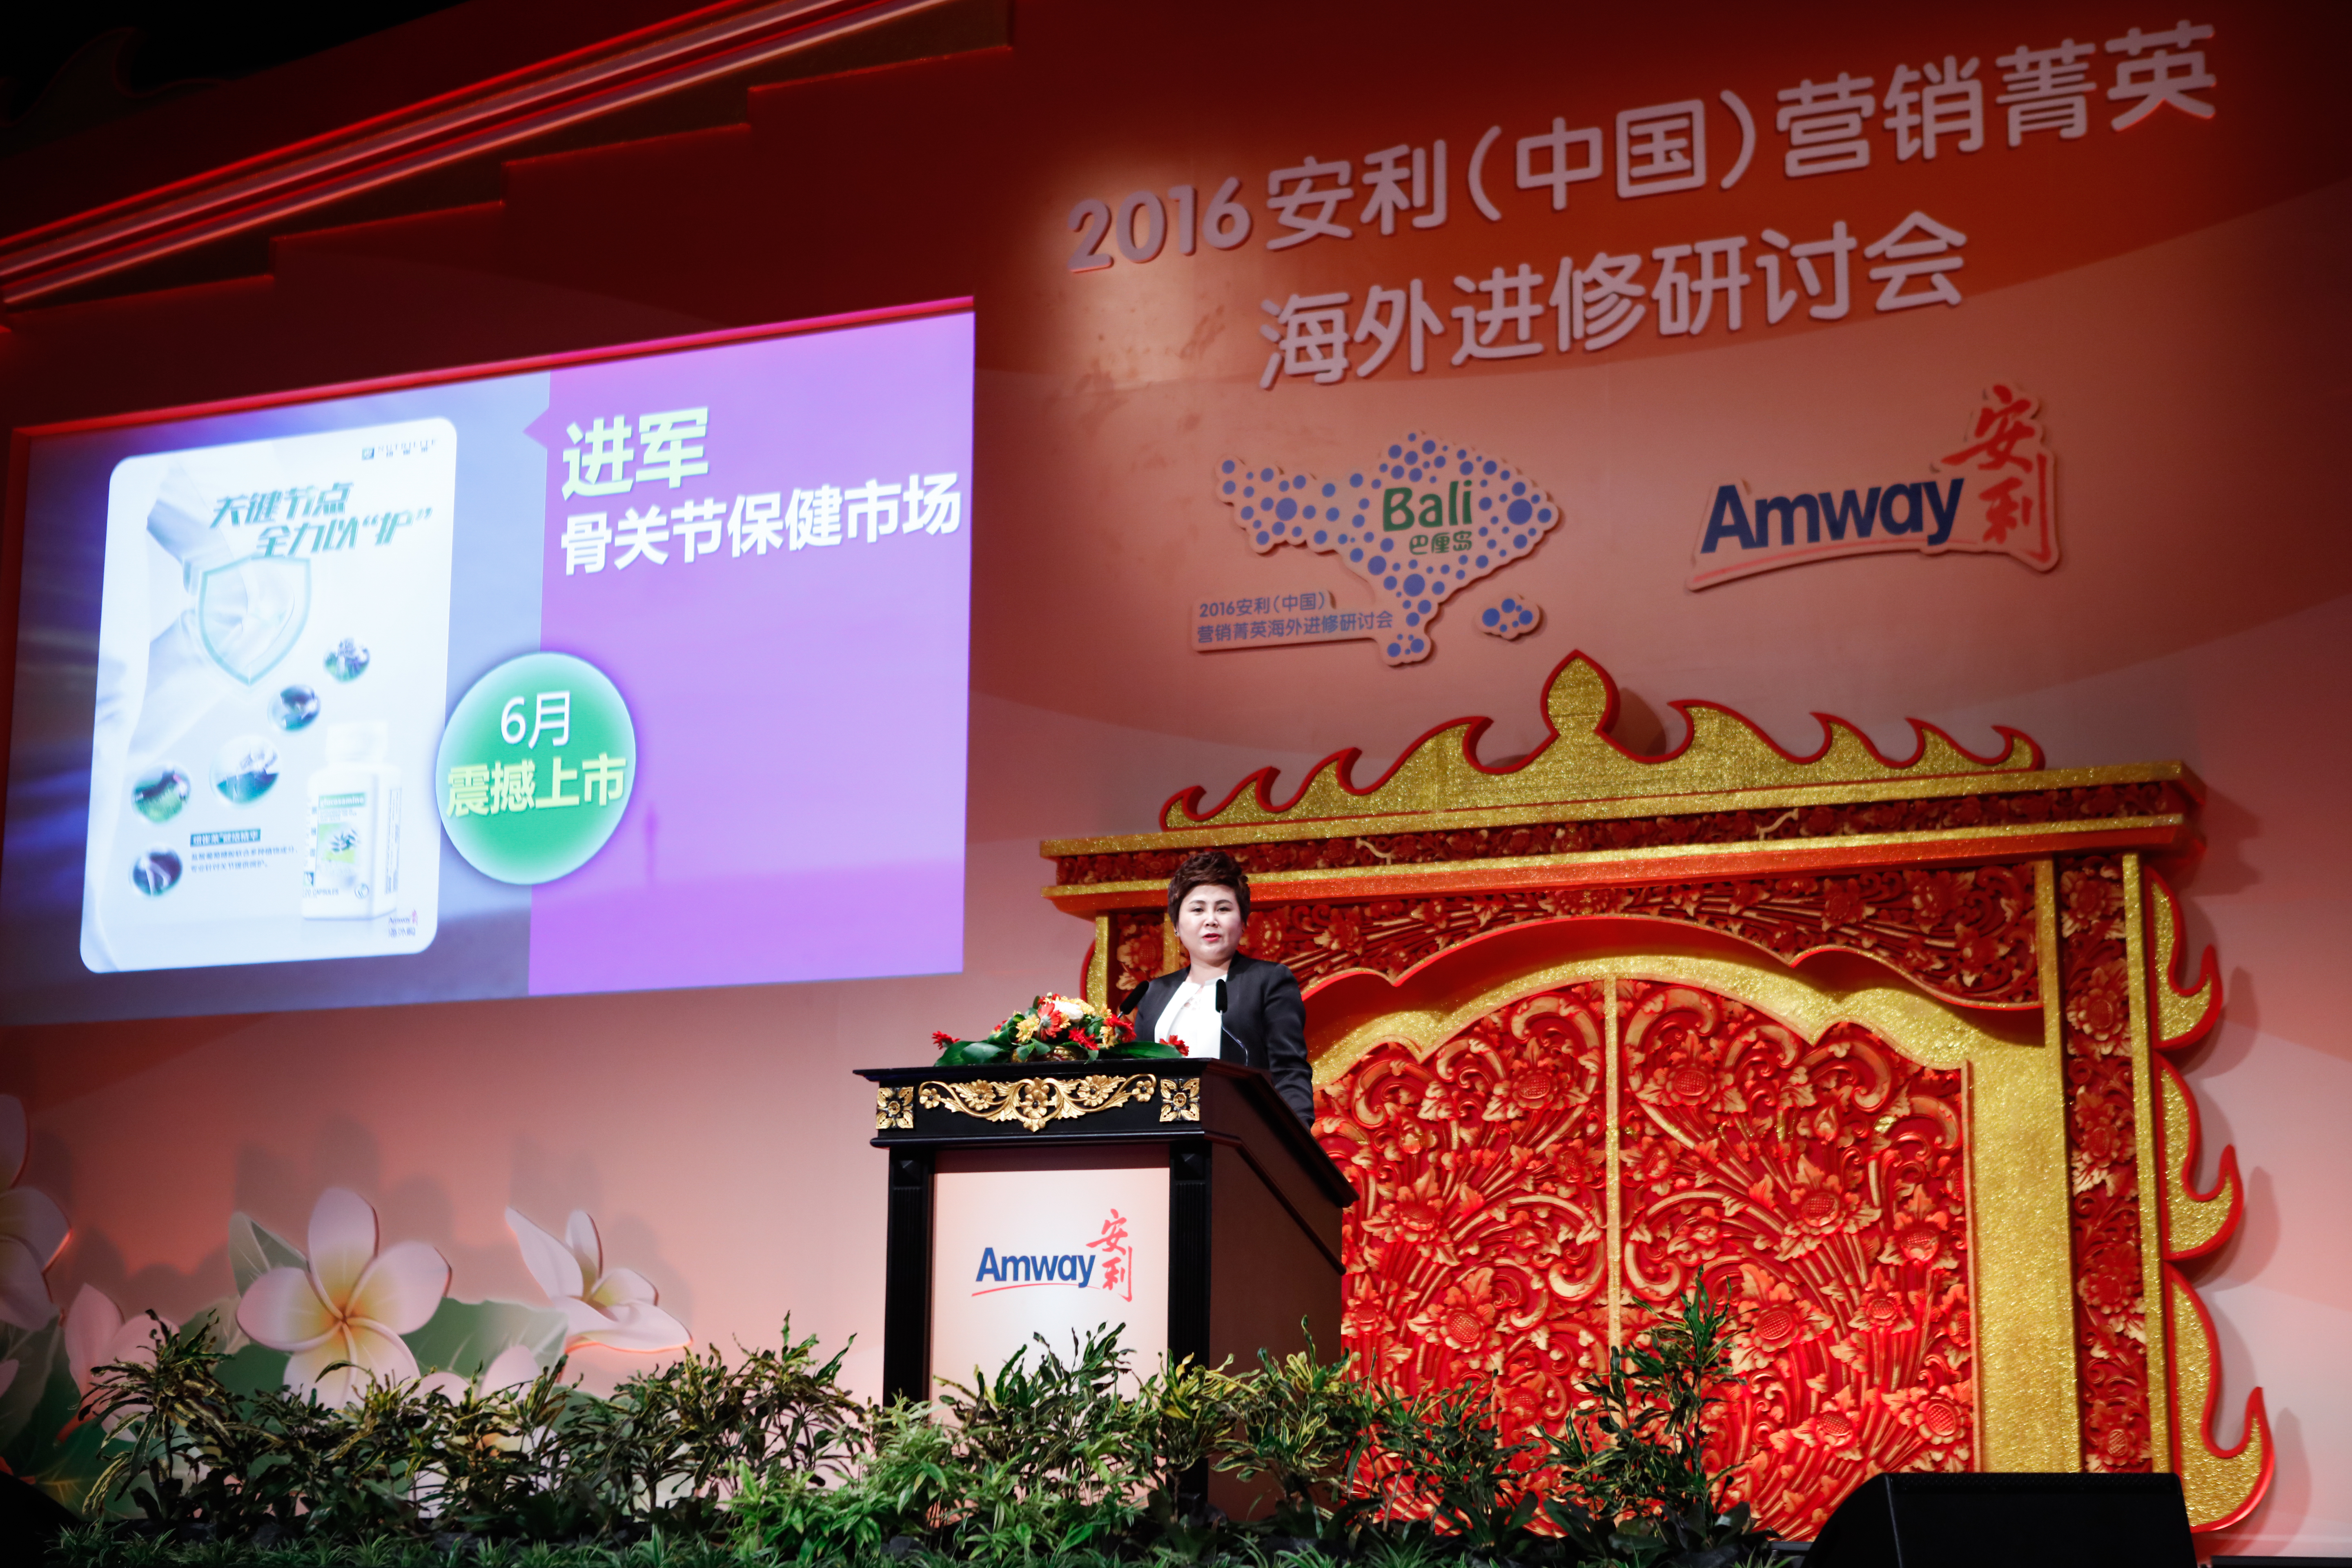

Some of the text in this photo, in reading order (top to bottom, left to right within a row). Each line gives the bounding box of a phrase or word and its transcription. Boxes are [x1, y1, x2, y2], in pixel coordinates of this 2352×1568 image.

[1259, 210, 1967, 390] 海外进修研讨会
[561, 406, 709, 501] 进军
[1941, 384, 2051, 563] 安利
[560, 472, 961, 576] 骨关节保健市场
[1382, 480, 1472, 532] Bali
[1700, 478, 1964, 554] Amway
[1409, 530, 1472, 555] 巴厘岛
[1197, 610, 1393, 644] 营销菁英海外进修研讨会
[1199, 591, 1325, 618] 2016安利（中国）
[501, 690, 570, 749] 6月
[446, 752, 626, 817] 震撼上市
[976, 1247, 1096, 1288] Amway
[1086, 1208, 1132, 1302] 安利
